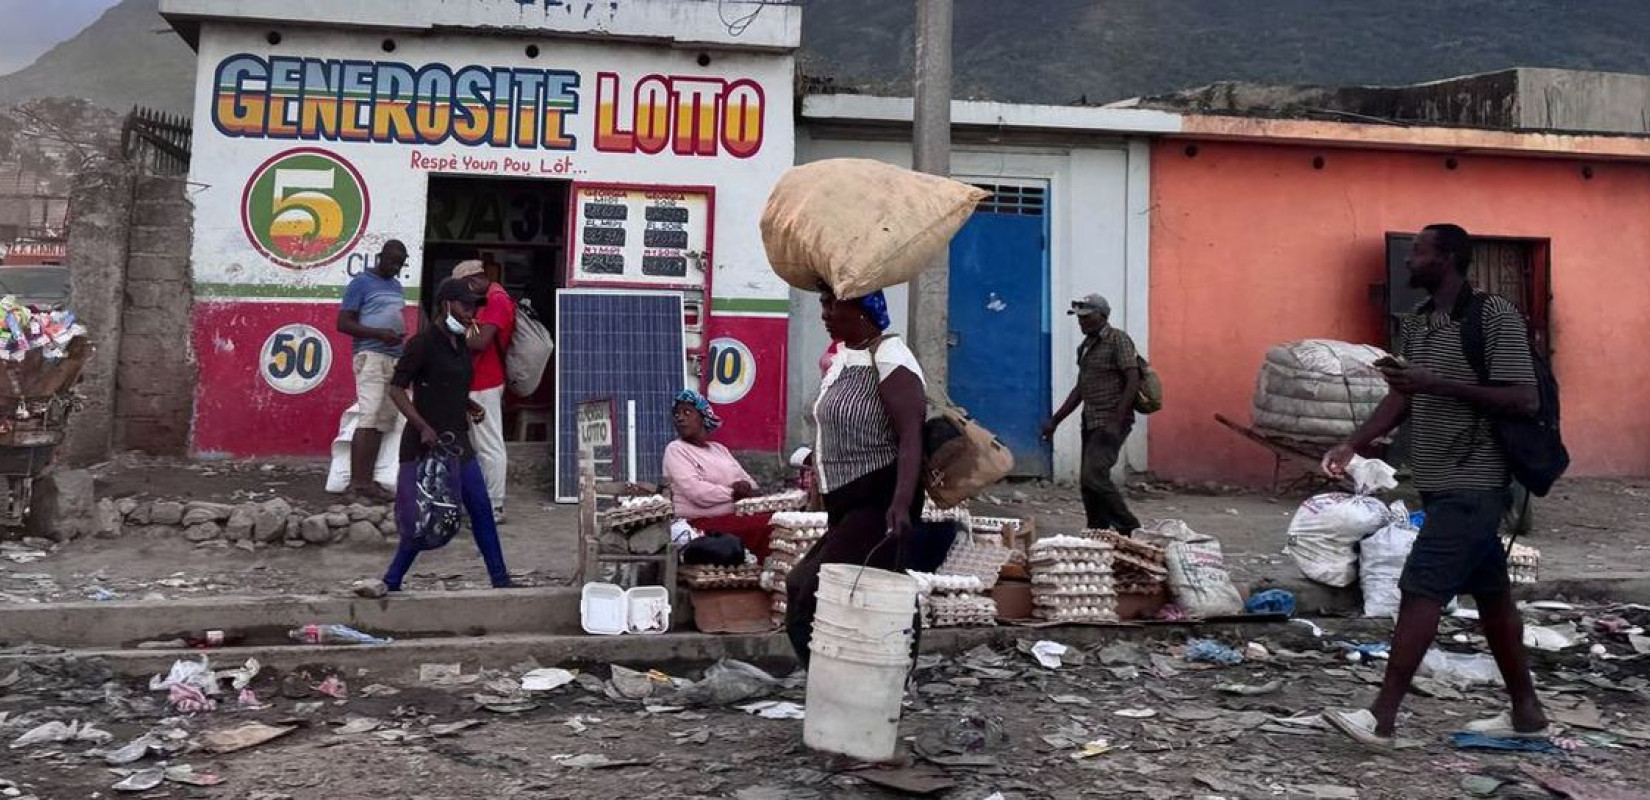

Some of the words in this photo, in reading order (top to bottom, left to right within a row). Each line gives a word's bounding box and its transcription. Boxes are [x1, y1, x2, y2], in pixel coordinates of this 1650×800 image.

[211, 53, 580, 150] GENEROSITE
[594, 72, 765, 159] LOTTO
[411, 150, 457, 171] Respè
[463, 156, 498, 171] Youn
[504, 157, 531, 172] Pou
[270, 167, 343, 257] 5
[268, 333, 322, 380] 50
